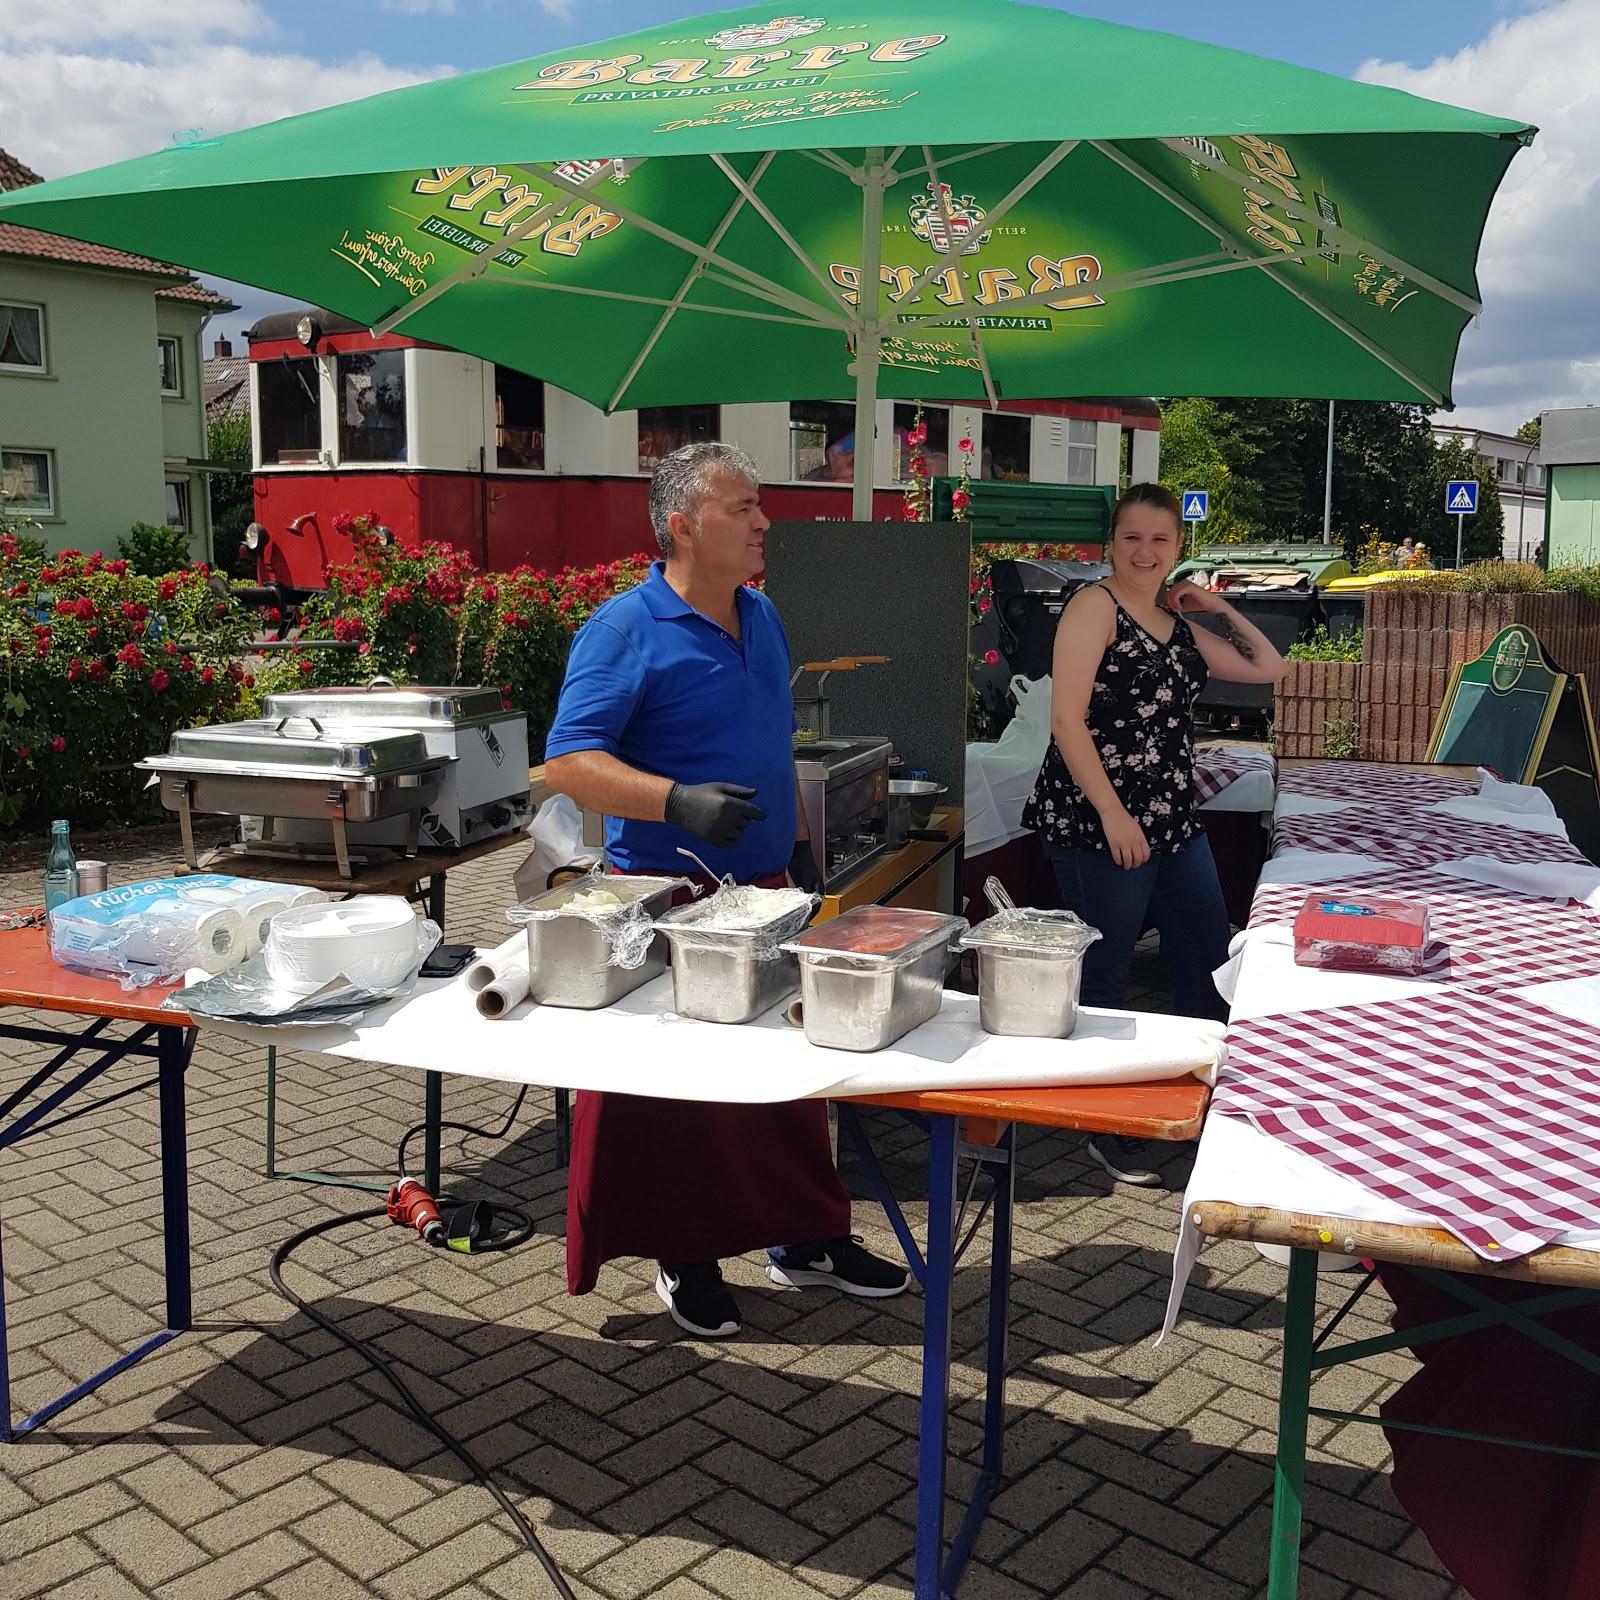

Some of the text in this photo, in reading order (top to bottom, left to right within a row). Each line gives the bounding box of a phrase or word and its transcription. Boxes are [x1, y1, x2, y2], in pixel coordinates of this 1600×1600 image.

[512, 33, 947, 91] Barre
[581, 75, 820, 103] PRIVATBRAUEREI
[704, 98, 797, 116] Barre
[653, 113, 740, 133] Dein
[1496, 653, 1524, 667] Barre
